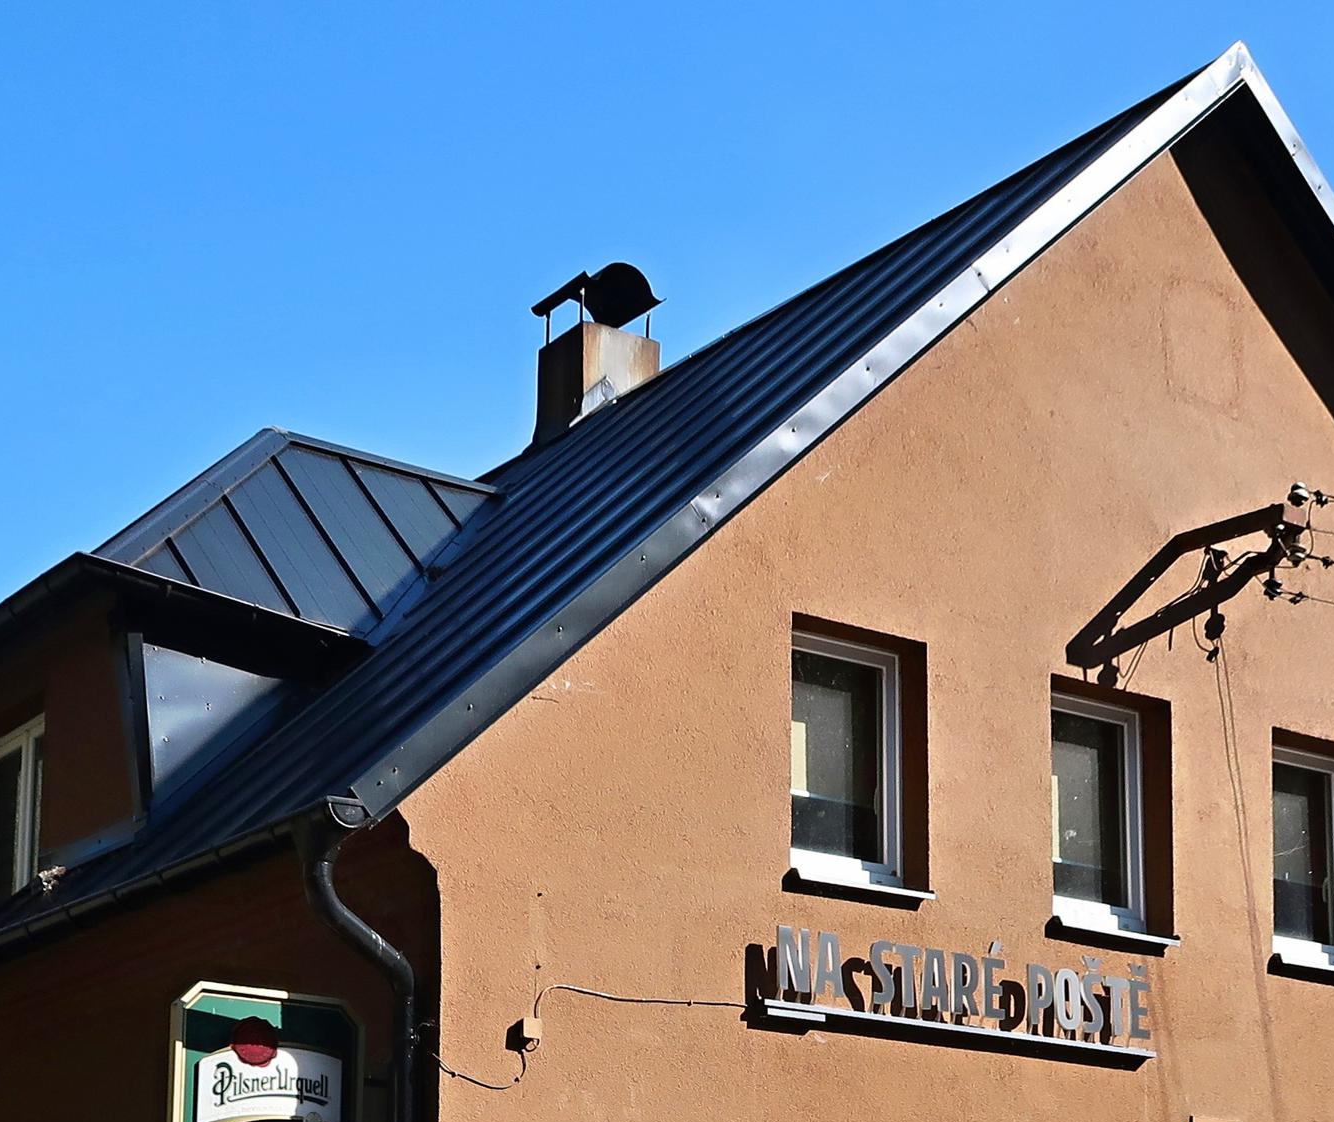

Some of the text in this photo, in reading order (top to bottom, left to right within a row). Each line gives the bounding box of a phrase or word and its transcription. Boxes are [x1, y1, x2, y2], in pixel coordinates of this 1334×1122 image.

[777, 924, 1151, 1040] NA STARÉ POŠTĚ
[212, 1061, 329, 1107] Pilsner Urquell
